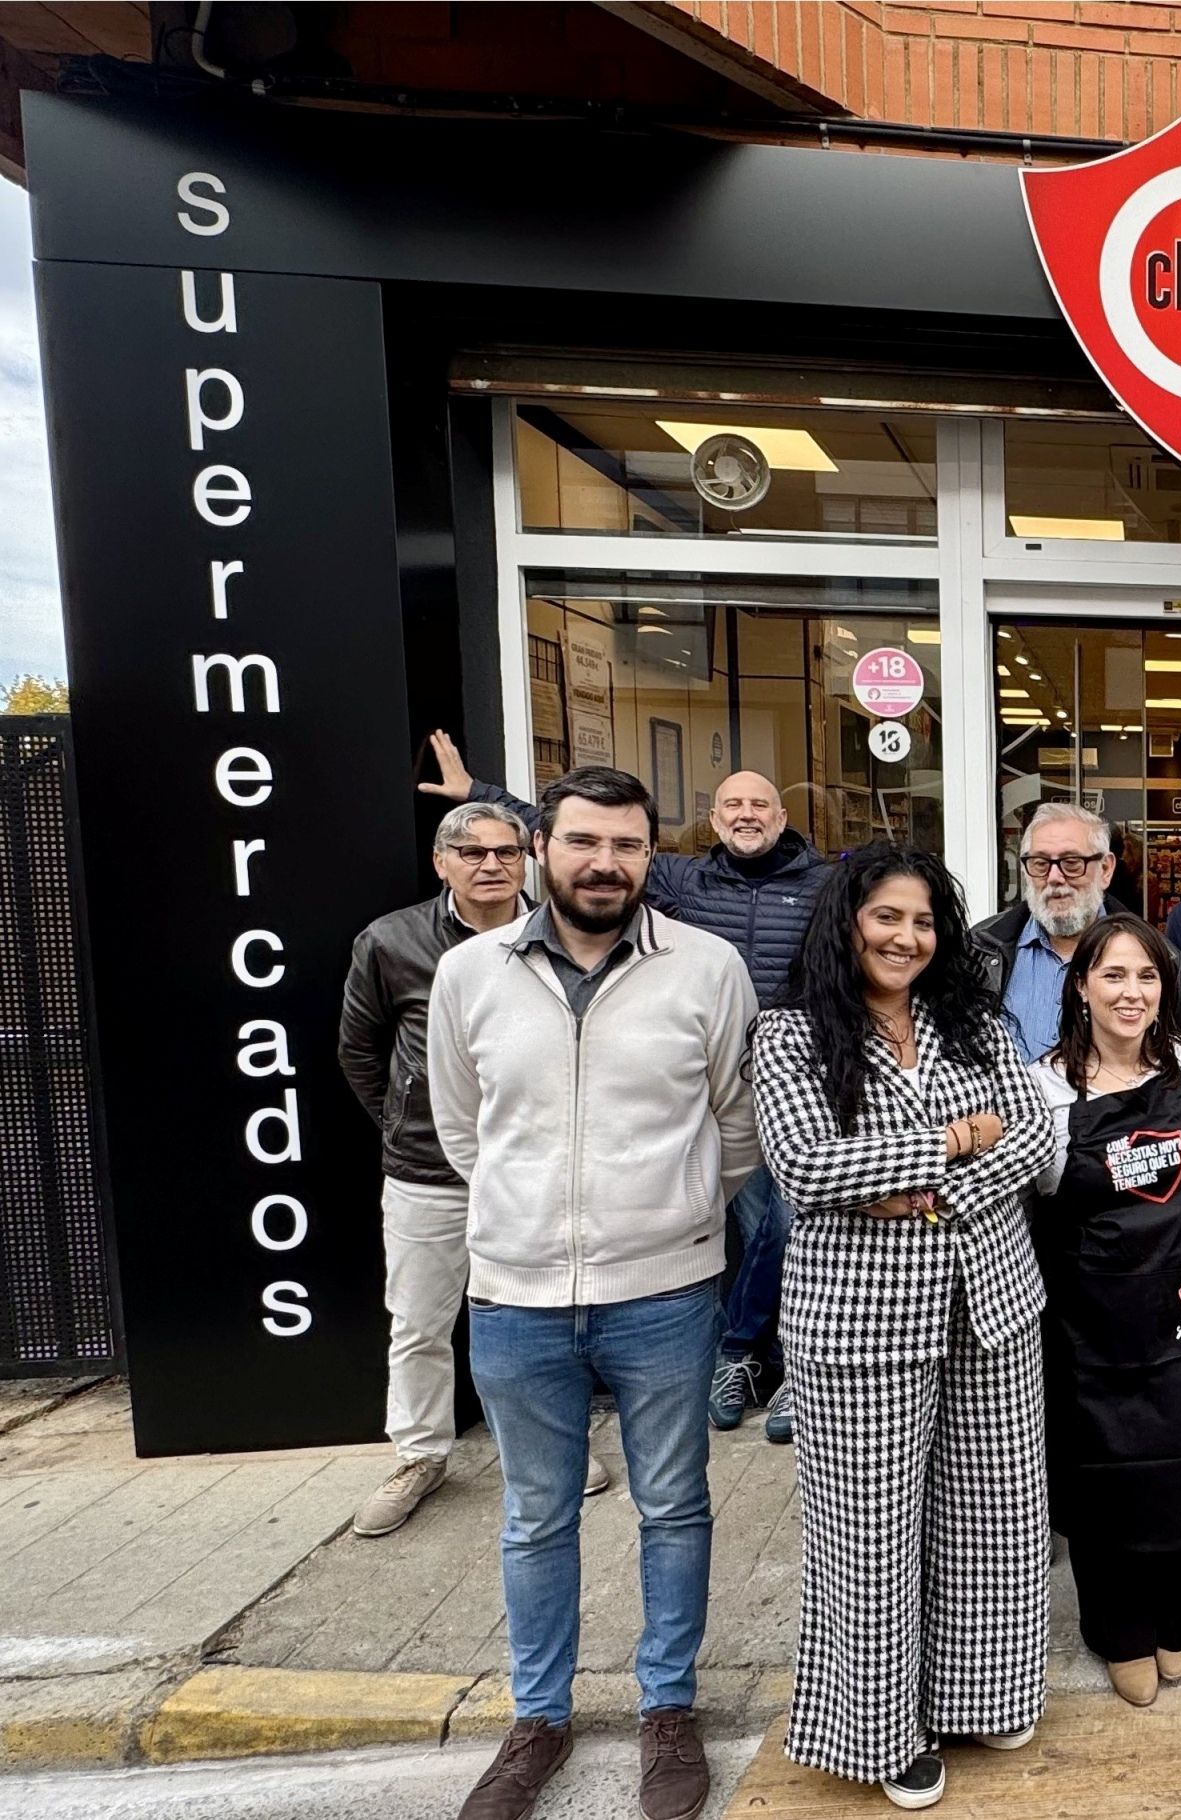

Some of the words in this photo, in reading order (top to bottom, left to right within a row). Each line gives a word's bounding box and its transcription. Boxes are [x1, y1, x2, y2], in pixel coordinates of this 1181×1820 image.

[867, 655, 906, 678] +18
[177, 171, 312, 1337] supermercados
[1107, 1143, 1158, 1166] NECESITAS
[1158, 1137, 1181, 1155] HOY?
[1111, 1160, 1148, 1179] SEGURO
[1149, 1155, 1168, 1172] QUE
[1168, 1151, 1181, 1166] LO
[1112, 1171, 1158, 1192] TENEMOS
